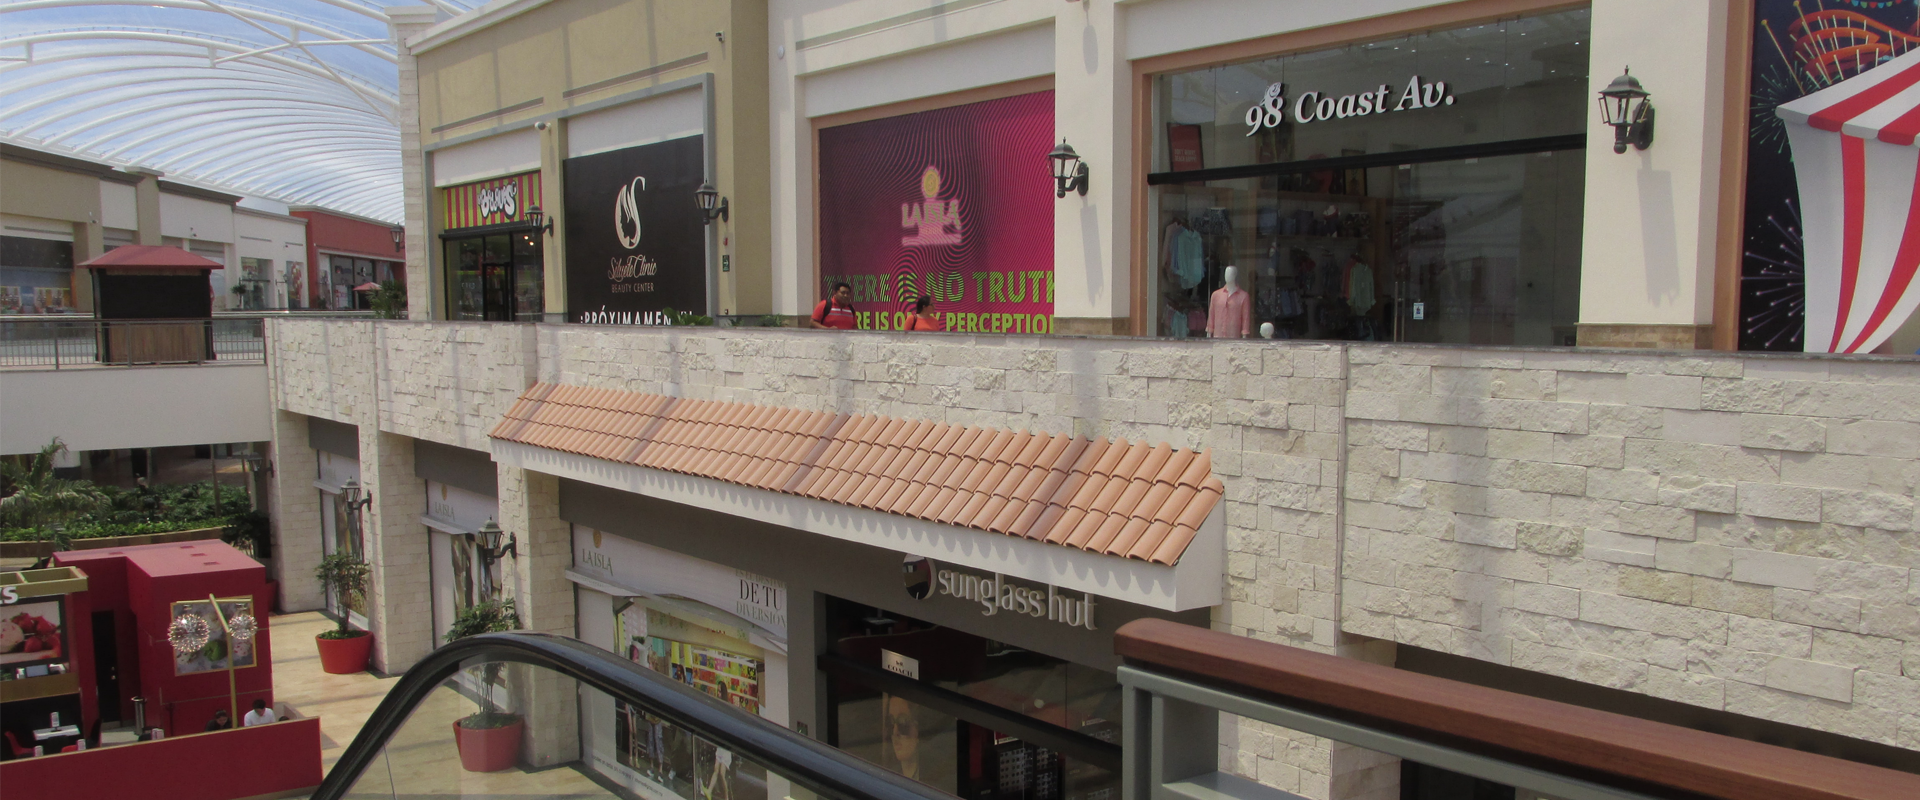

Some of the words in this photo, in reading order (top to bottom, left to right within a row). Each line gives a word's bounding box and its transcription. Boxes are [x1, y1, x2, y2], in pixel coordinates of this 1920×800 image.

[1245, 88, 1283, 137] 98
[1295, 84, 1389, 123] Coast
[1393, 75, 1454, 111] Av.
[633, 254, 658, 279] Clinic
[611, 283, 632, 293] BEAUTY
[633, 282, 655, 293] CENTER
[925, 271, 964, 302] NO
[875, 311, 890, 331] IS
[740, 579, 760, 605] DE
[762, 585, 782, 611] TU
[938, 569, 1046, 617] sunglass
[1049, 584, 1098, 631] hut
